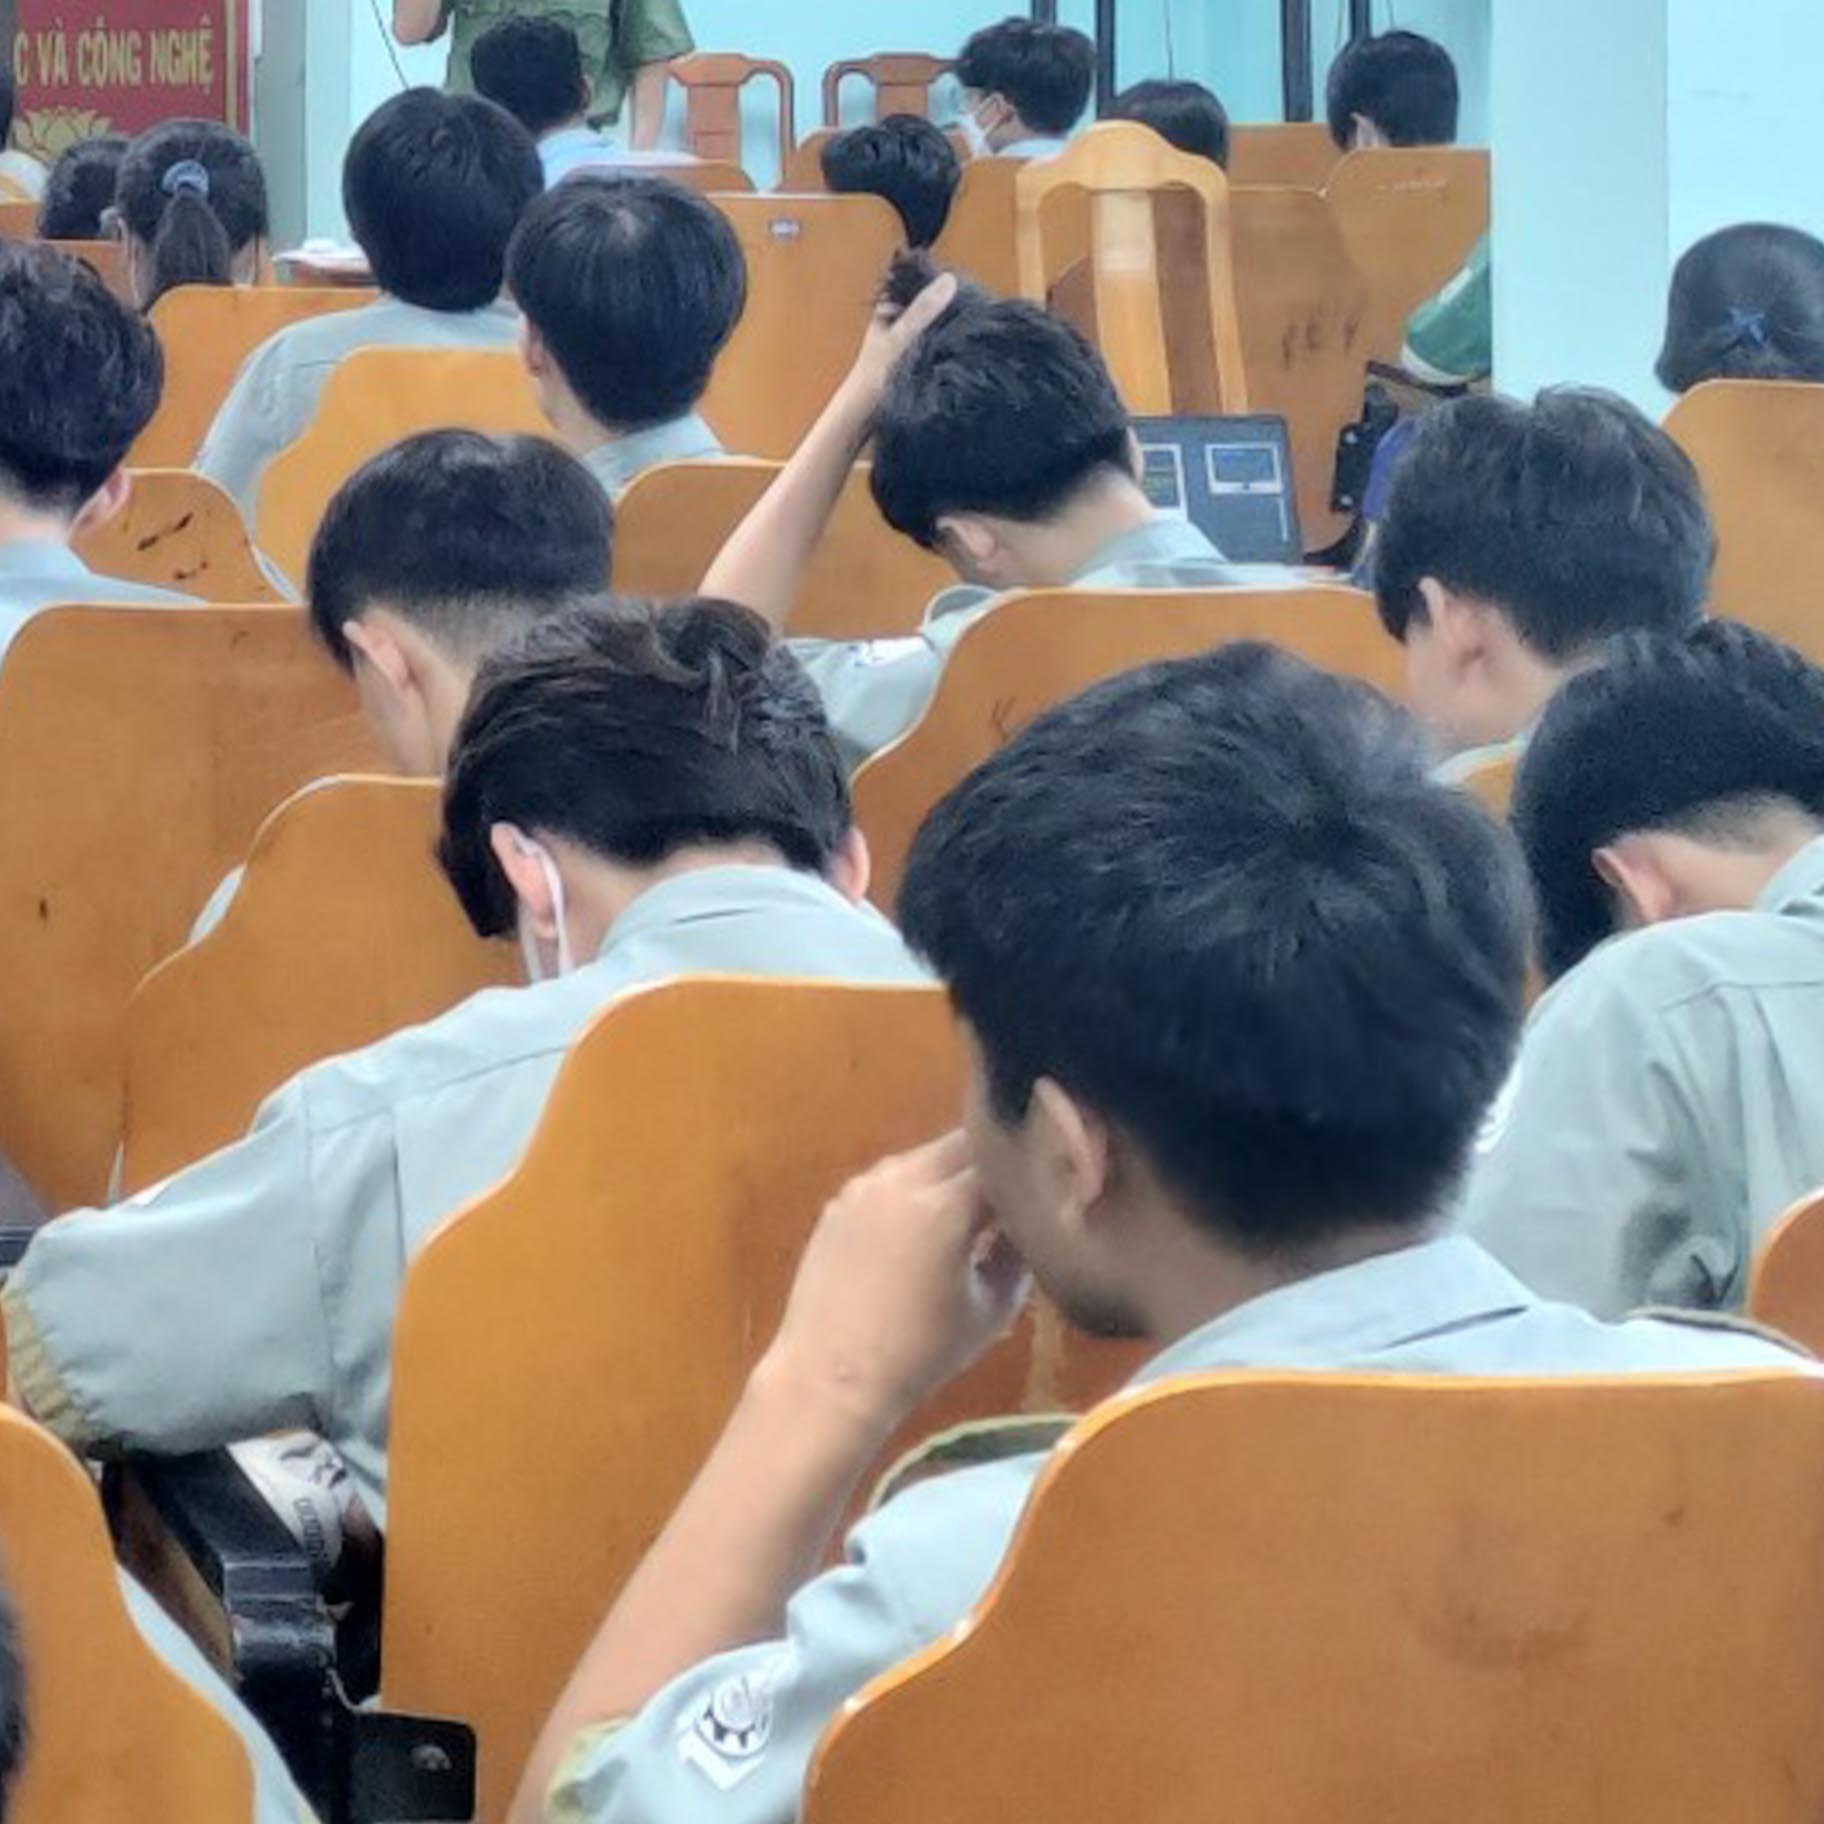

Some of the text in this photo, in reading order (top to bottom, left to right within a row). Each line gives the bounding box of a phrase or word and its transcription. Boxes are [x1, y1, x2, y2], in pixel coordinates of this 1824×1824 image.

[36, 18, 70, 87] VÀ
[76, 16, 142, 87] CÔNG
[149, 13, 213, 94] NGHỆ
